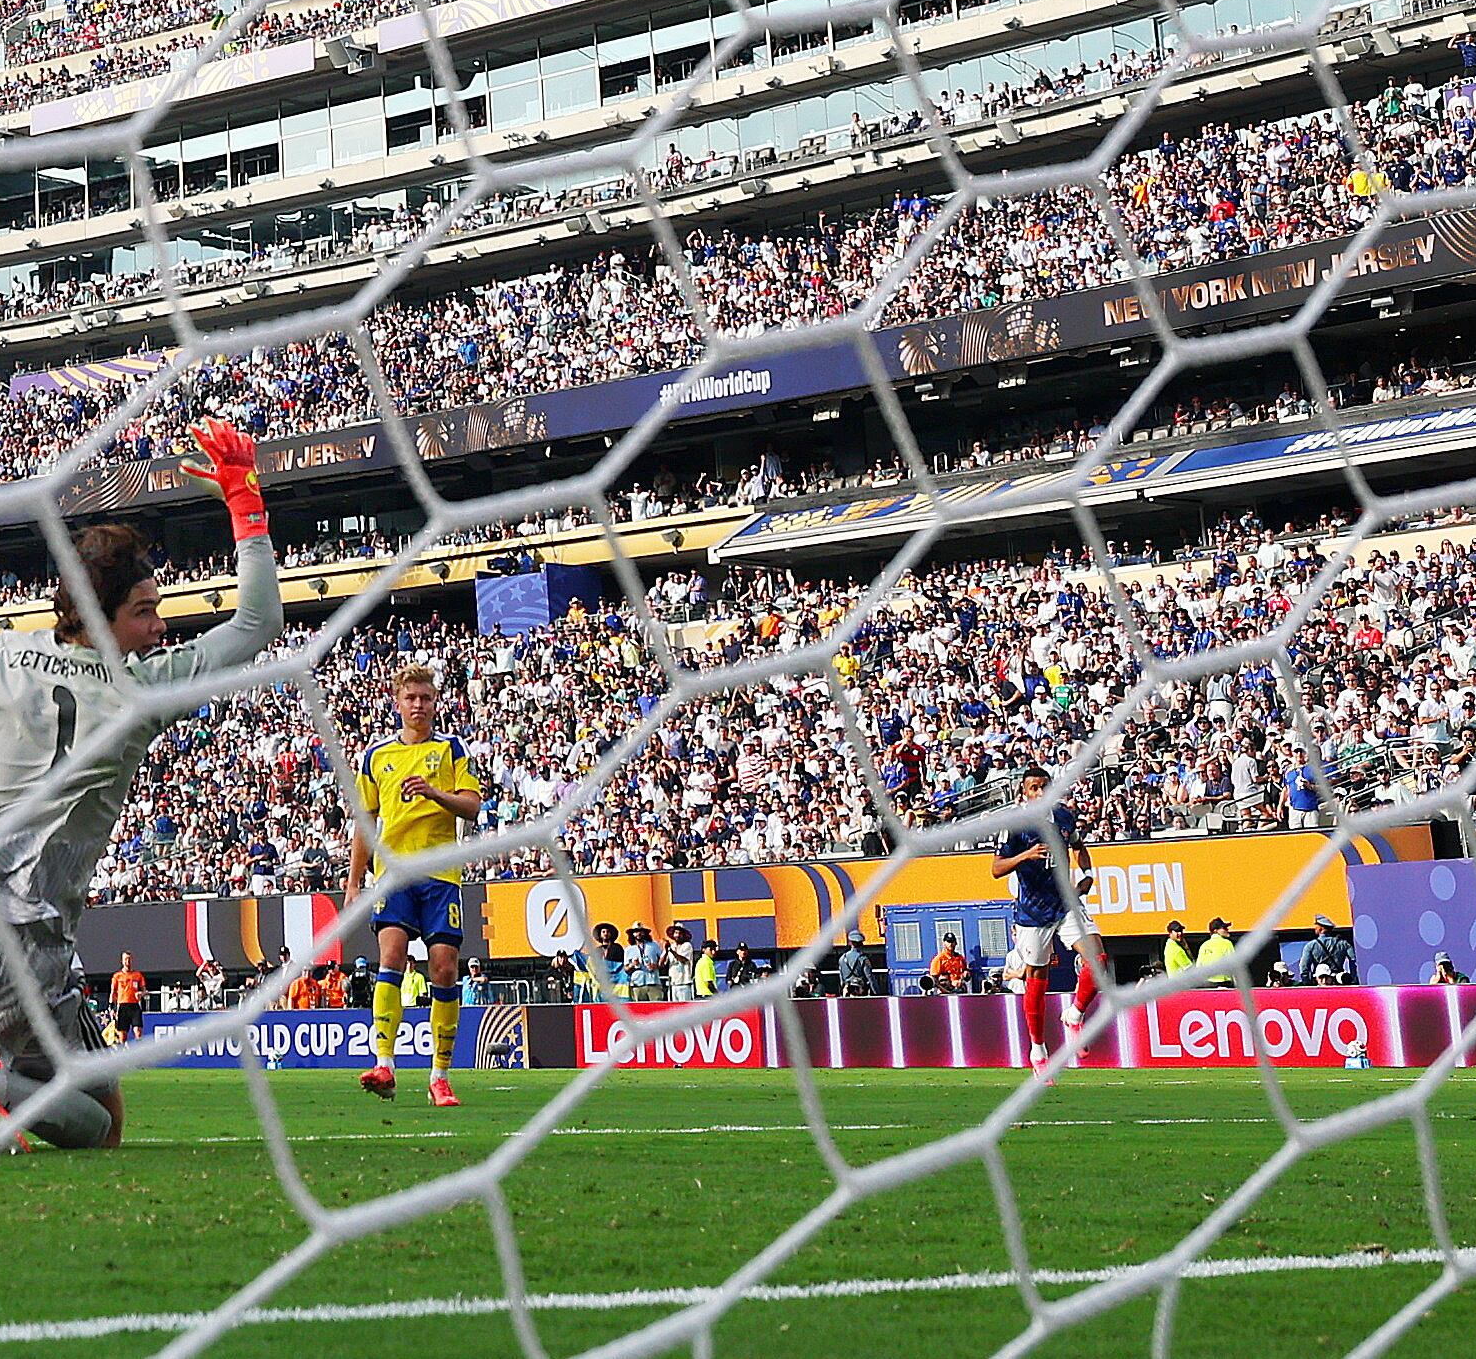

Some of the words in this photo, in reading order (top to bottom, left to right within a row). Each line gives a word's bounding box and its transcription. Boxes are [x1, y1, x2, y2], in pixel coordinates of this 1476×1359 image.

[1172, 274, 1245, 311] YORK
[1251, 258, 1316, 296] NEW
[296, 435, 376, 468] JERSEY
[49, 685, 77, 770] 1
[448, 902, 460, 928] 8
[295, 1023, 344, 1056] CUP
[582, 1009, 753, 1064] Lenovo
[1147, 999, 1368, 1059] Lenovo
